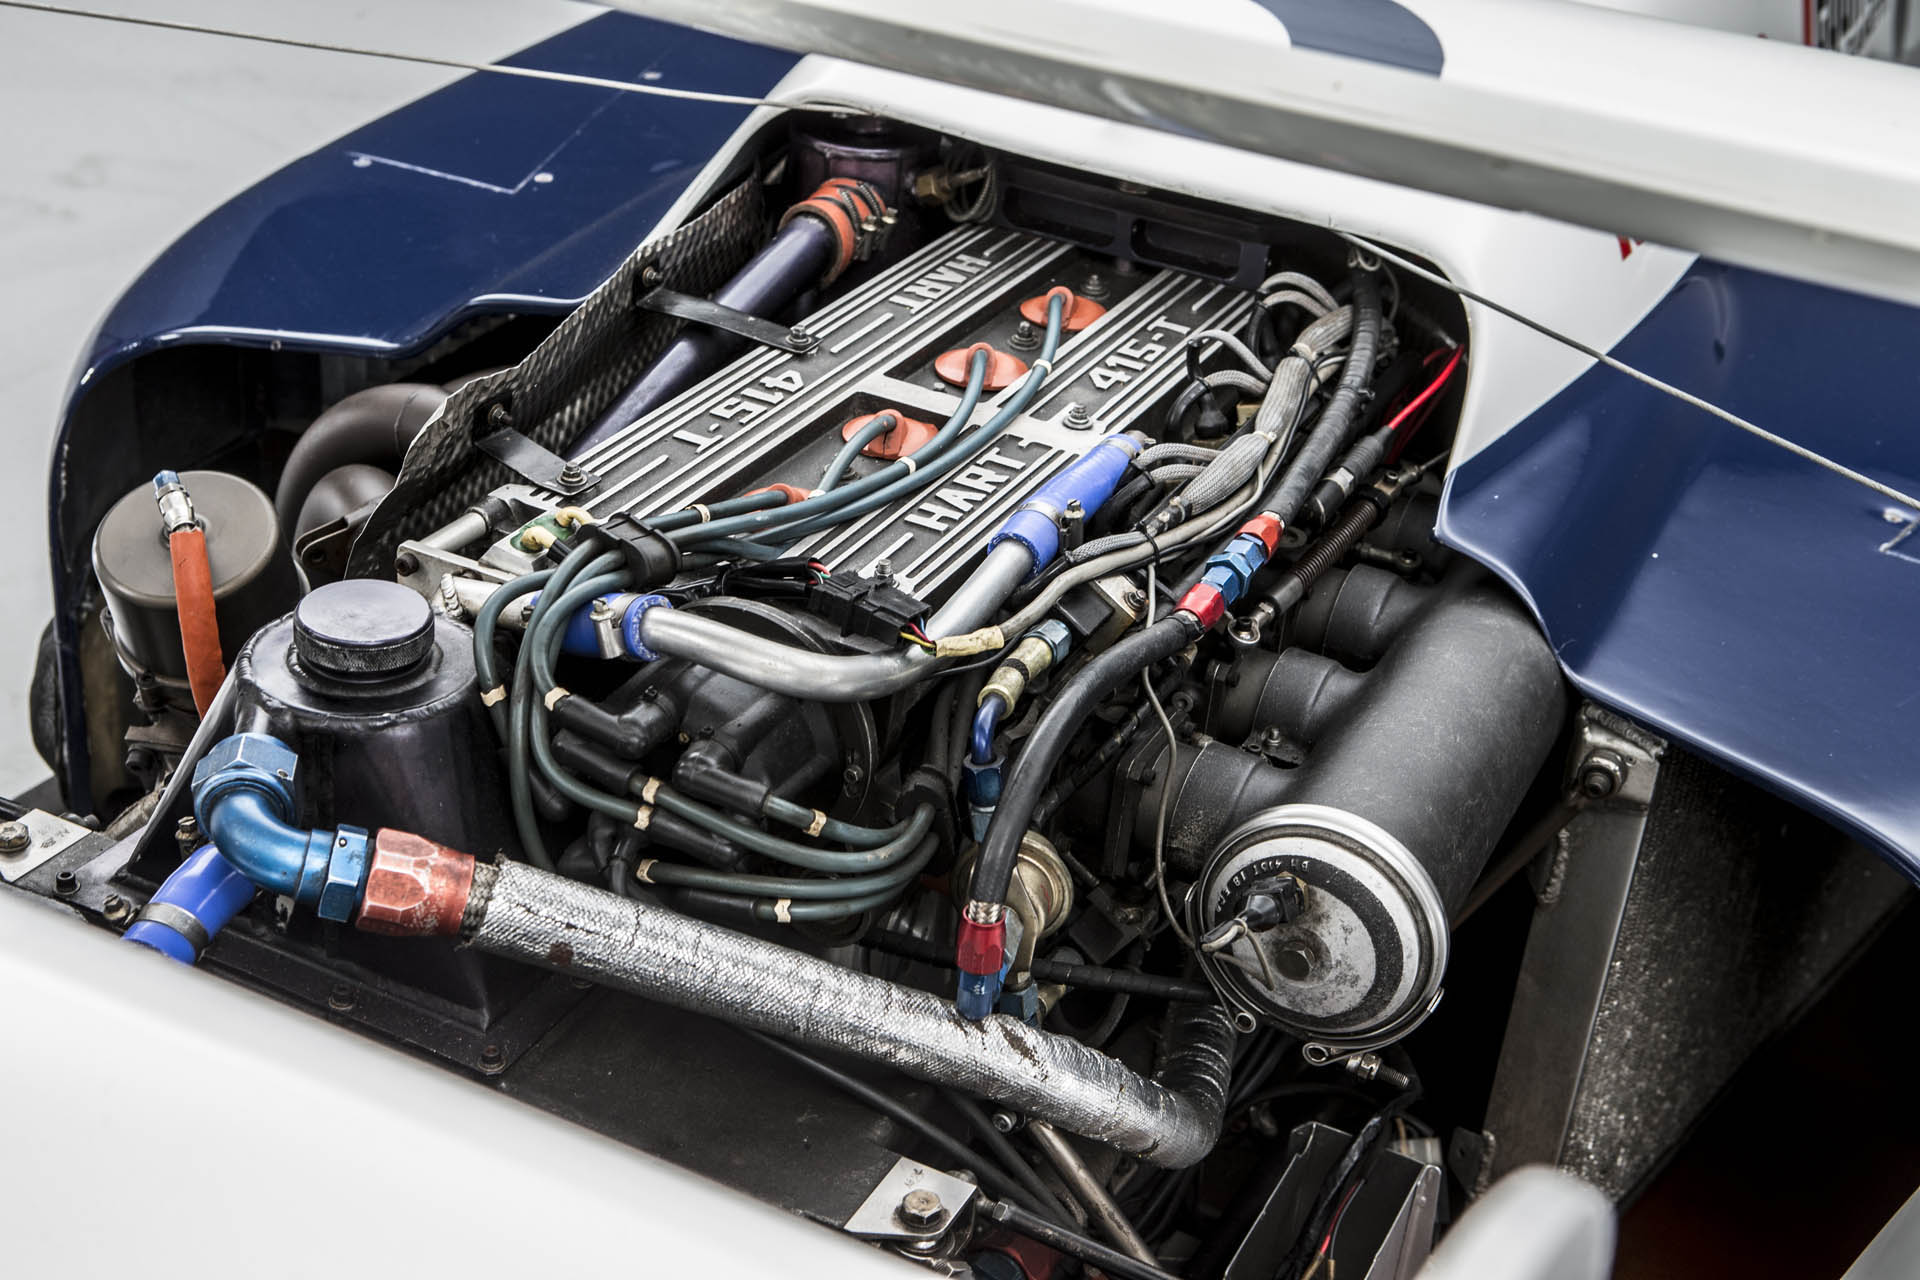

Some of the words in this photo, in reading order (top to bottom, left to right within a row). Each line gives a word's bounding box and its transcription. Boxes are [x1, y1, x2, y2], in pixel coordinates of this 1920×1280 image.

[889, 254, 992, 314] HART
[1088, 316, 1191, 391] 415-T
[905, 446, 1026, 532] HART
